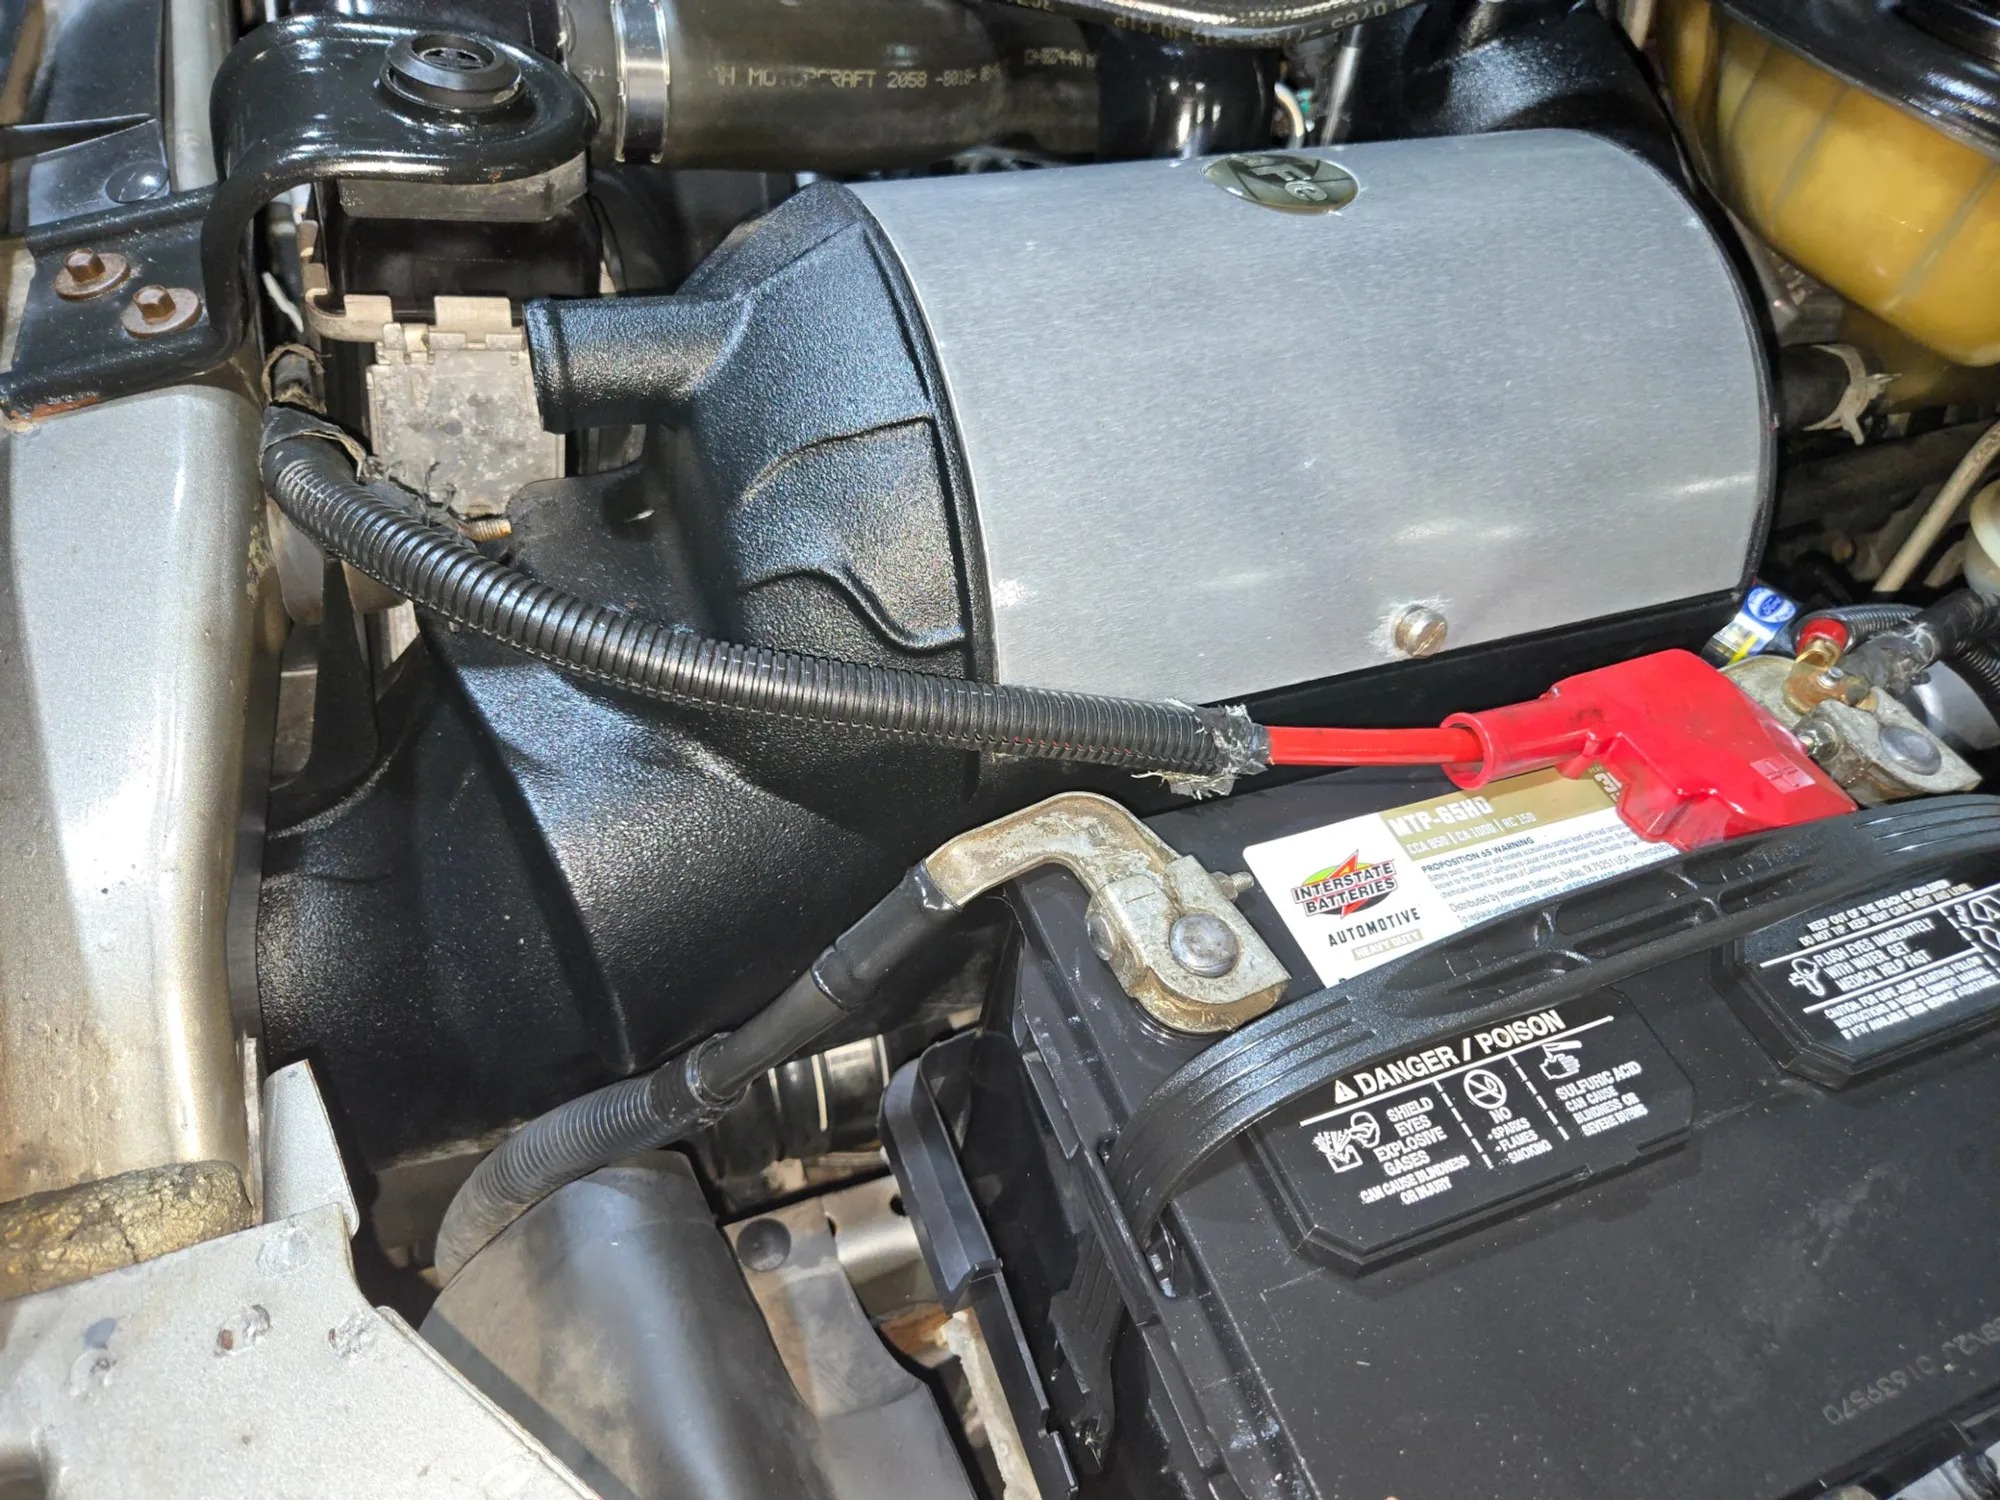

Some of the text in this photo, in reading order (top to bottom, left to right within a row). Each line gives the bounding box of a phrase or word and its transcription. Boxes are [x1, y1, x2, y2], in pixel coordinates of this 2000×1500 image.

[886, 71, 928, 89] 2058
[1387, 797, 1493, 837] MTP-65HD
[1406, 841, 1429, 854] CCA
[1454, 830, 1472, 841] CA
[1516, 812, 1536, 824] 150
[1421, 837, 1534, 872] PROPOSITION 65 WARNING
[1294, 863, 1393, 901] INTERSTATE
[1497, 884, 1532, 898] Interstate
[1582, 865, 1593, 873] TX
[1591, 858, 1615, 872] 75251
[1614, 854, 1631, 865] USA
[1305, 878, 1395, 914] BATTERIES
[1807, 918, 1829, 931] KEEP
[1829, 912, 1848, 924] OUT
[1846, 908, 1859, 918] OF
[1858, 903, 1878, 914] THE
[1874, 895, 1903, 909] REACH
[1900, 890, 1913, 901] OF
[1328, 908, 1421, 947] AUTOMOTIVE
[1798, 935, 1814, 946] DO
[1812, 929, 1832, 941] NOT
[1847, 917, 1869, 930] KEEP
[1868, 910, 1890, 922] VENT
[1889, 903, 1912, 916] CAPS
[1909, 895, 1934, 909] TIGHT
[1353, 939, 1392, 959] HEAVY
[1813, 918, 1934, 967] FLUSH EYES IMMEDIATELY
[1823, 962, 1854, 979] WITH
[1887, 941, 1910, 957] GET
[1835, 950, 1931, 991] MEDICAL HELP FAST
[1858, 994, 1878, 1007] FOR
[1353, 1046, 1460, 1096] DANGER
[1475, 1010, 1566, 1054] POISON
[1555, 1061, 1641, 1100] SULFURIC ACID
[1565, 1085, 1618, 1112] CAN CAUSE
[1386, 1097, 1433, 1122] SHIELD
[1394, 1115, 1431, 1137] EYES
[1489, 1107, 1512, 1124] NO
[1573, 1093, 1639, 1123] BLINDNESS OR
[1582, 1104, 1648, 1135] SEVERE BURNS
[1373, 1126, 1447, 1162] EXPLOSIVE
[1360, 1155, 1470, 1203] CAN CAUSE BLINDNESS
[1384, 1150, 1430, 1176] GASES
[1400, 1176, 1452, 1204] OR INJURY
